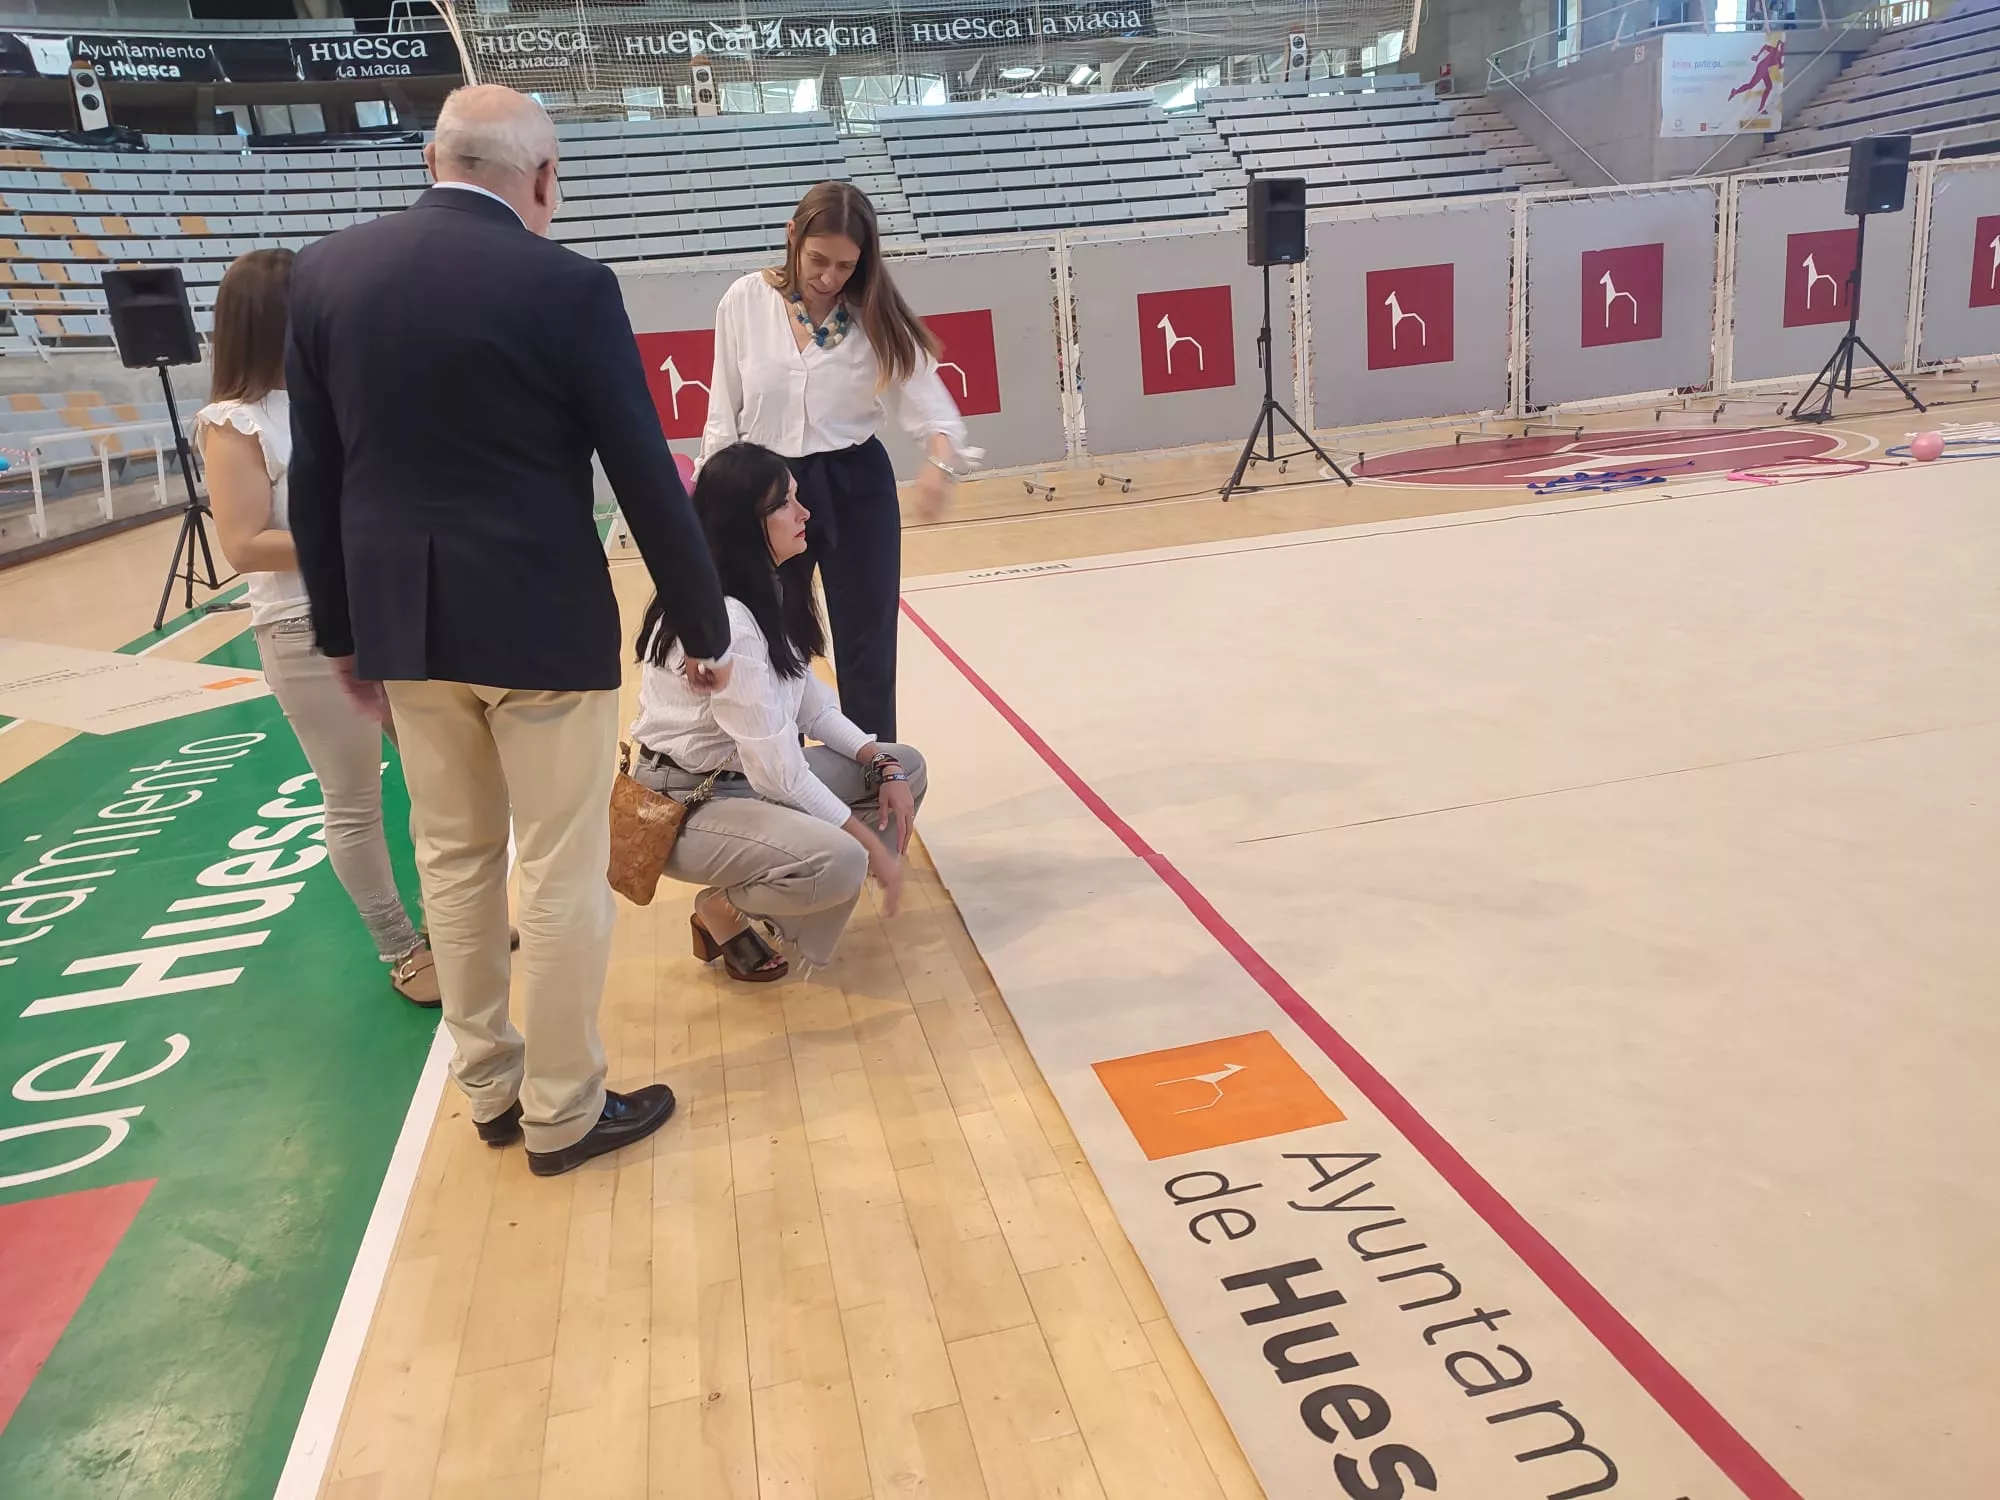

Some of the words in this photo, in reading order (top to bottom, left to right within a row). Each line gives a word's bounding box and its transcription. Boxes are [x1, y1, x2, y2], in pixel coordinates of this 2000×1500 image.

[78, 40, 206, 60] Ayuntamiento
[109, 60, 181, 78] Huesca
[1164, 1171, 1263, 1245] de
[1281, 1152, 1690, 1500] Ayuntam
